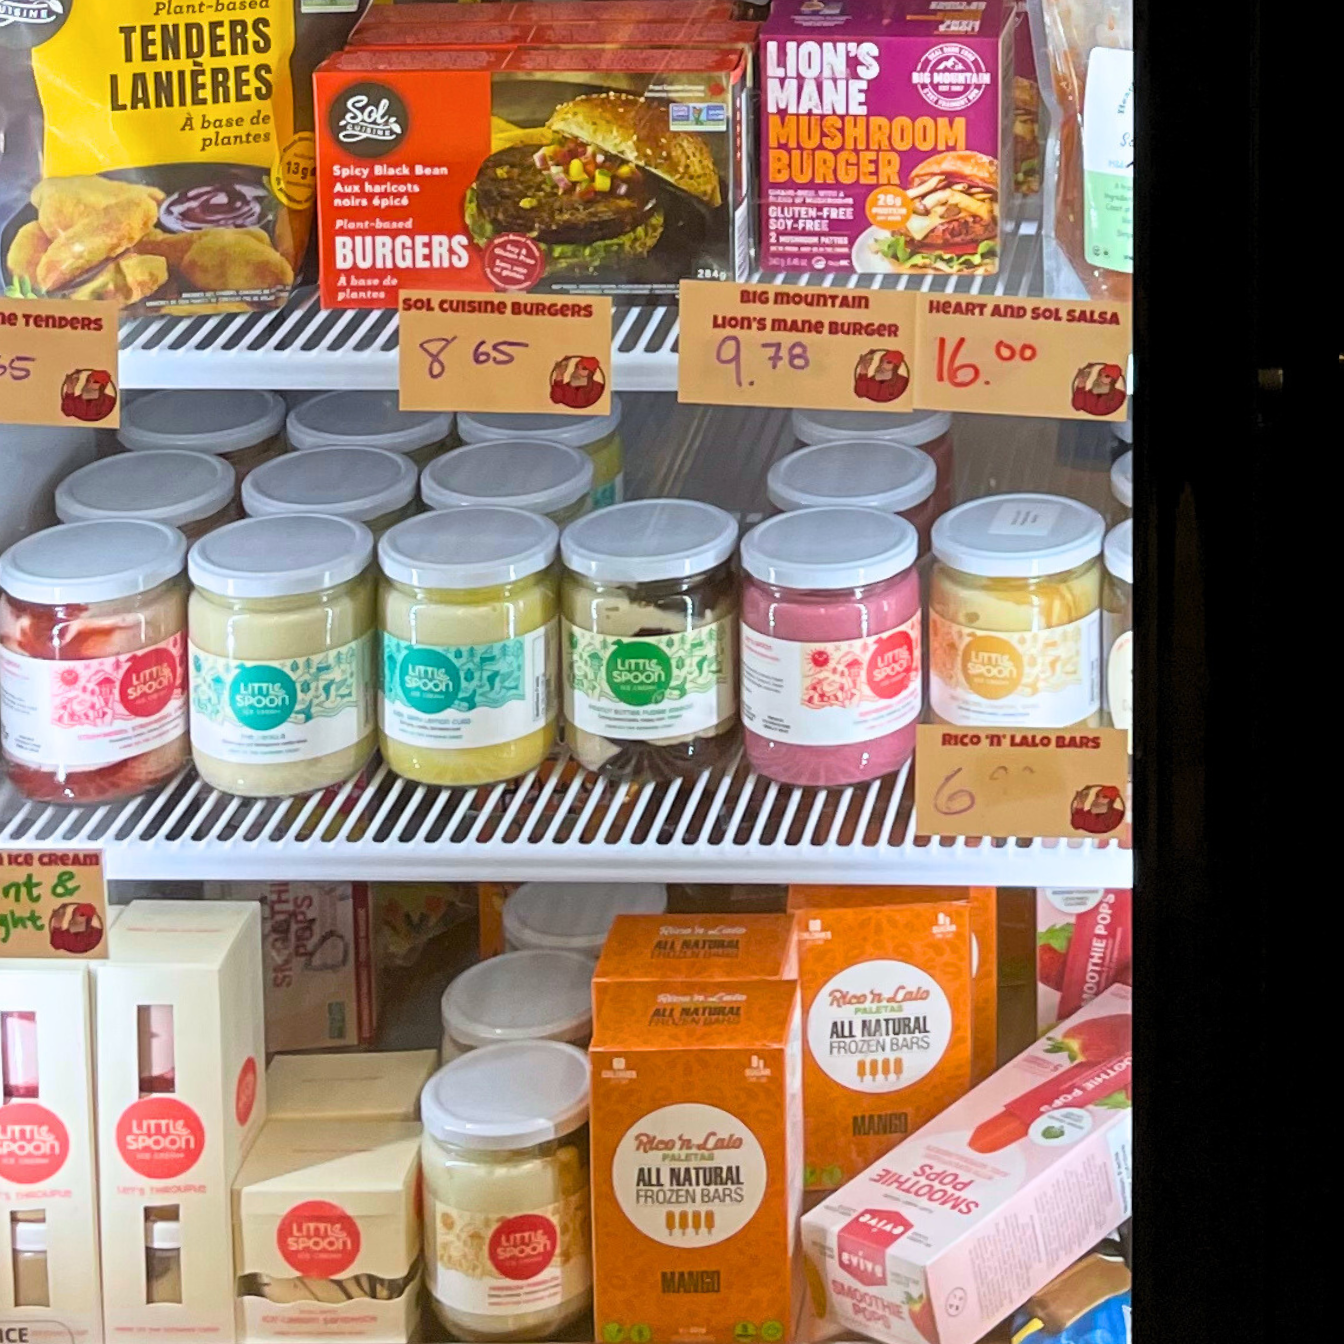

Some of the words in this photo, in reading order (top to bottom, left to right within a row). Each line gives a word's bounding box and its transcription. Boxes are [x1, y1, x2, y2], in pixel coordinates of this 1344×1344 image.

[118, 17, 272, 63] TENDERS
[766, 40, 880, 80] LION'S
[110, 59, 274, 112] LANIÈRES
[911, 71, 931, 84] BIG
[933, 71, 991, 85] MOUNTAIN
[766, 79, 867, 115] MANE
[345, 94, 390, 124] Sol
[200, 112, 245, 130] base
[250, 110, 271, 126] de
[200, 129, 271, 152] plantes
[768, 115, 967, 151] MUSHROOM
[332, 165, 370, 180] Spicy
[373, 164, 411, 176] Black
[414, 164, 449, 176] Bean
[768, 150, 900, 185] BURGER
[332, 181, 360, 193] Aux
[362, 181, 420, 193] haricots
[332, 195, 368, 207] noirs
[372, 194, 409, 210] épicé
[768, 206, 854, 220] GLUTEN-FREE
[335, 218, 413, 232] Plant-based
[768, 219, 829, 232] SOY-FREE
[335, 234, 470, 270] BURGERS
[350, 275, 379, 287] base
[382, 274, 398, 287] de
[696, 268, 727, 281] 284g
[337, 287, 386, 302] plantes
[740, 290, 769, 305] BIG
[1065, 307, 1121, 326] SALSA
[715, 335, 811, 388] 9.78
[935, 336, 1038, 388] 16.00
[616, 659, 662, 672] LITTLE
[612, 670, 666, 684] SPOON
[240, 681, 284, 695] LITTLE
[942, 733, 982, 747] RICO
[1009, 735, 1051, 749] LALO
[1054, 735, 1101, 750] BARS
[1094, 893, 1116, 935] POPS
[853, 1005, 904, 1015] PALETAS
[830, 1019, 859, 1039] ALL
[862, 1016, 931, 1037] NATURAL
[829, 1039, 886, 1055] FROZEN
[889, 1035, 931, 1052] BARS
[131, 1118, 191, 1136] LITTLE
[852, 1112, 909, 1136] MANGO
[126, 1134, 195, 1150] SPOON
[661, 1153, 715, 1162] PALETAS
[636, 1167, 665, 1187] ALL
[669, 1166, 744, 1186] NATURAL
[912, 1163, 974, 1192] POPS
[635, 1188, 696, 1205] FROZEN
[700, 1187, 744, 1205] BARS
[868, 1168, 980, 1216] SMOOTHIE
[292, 1223, 348, 1238] LITTLE
[286, 1236, 352, 1251] SPOON
[661, 1270, 721, 1294] MANGO
